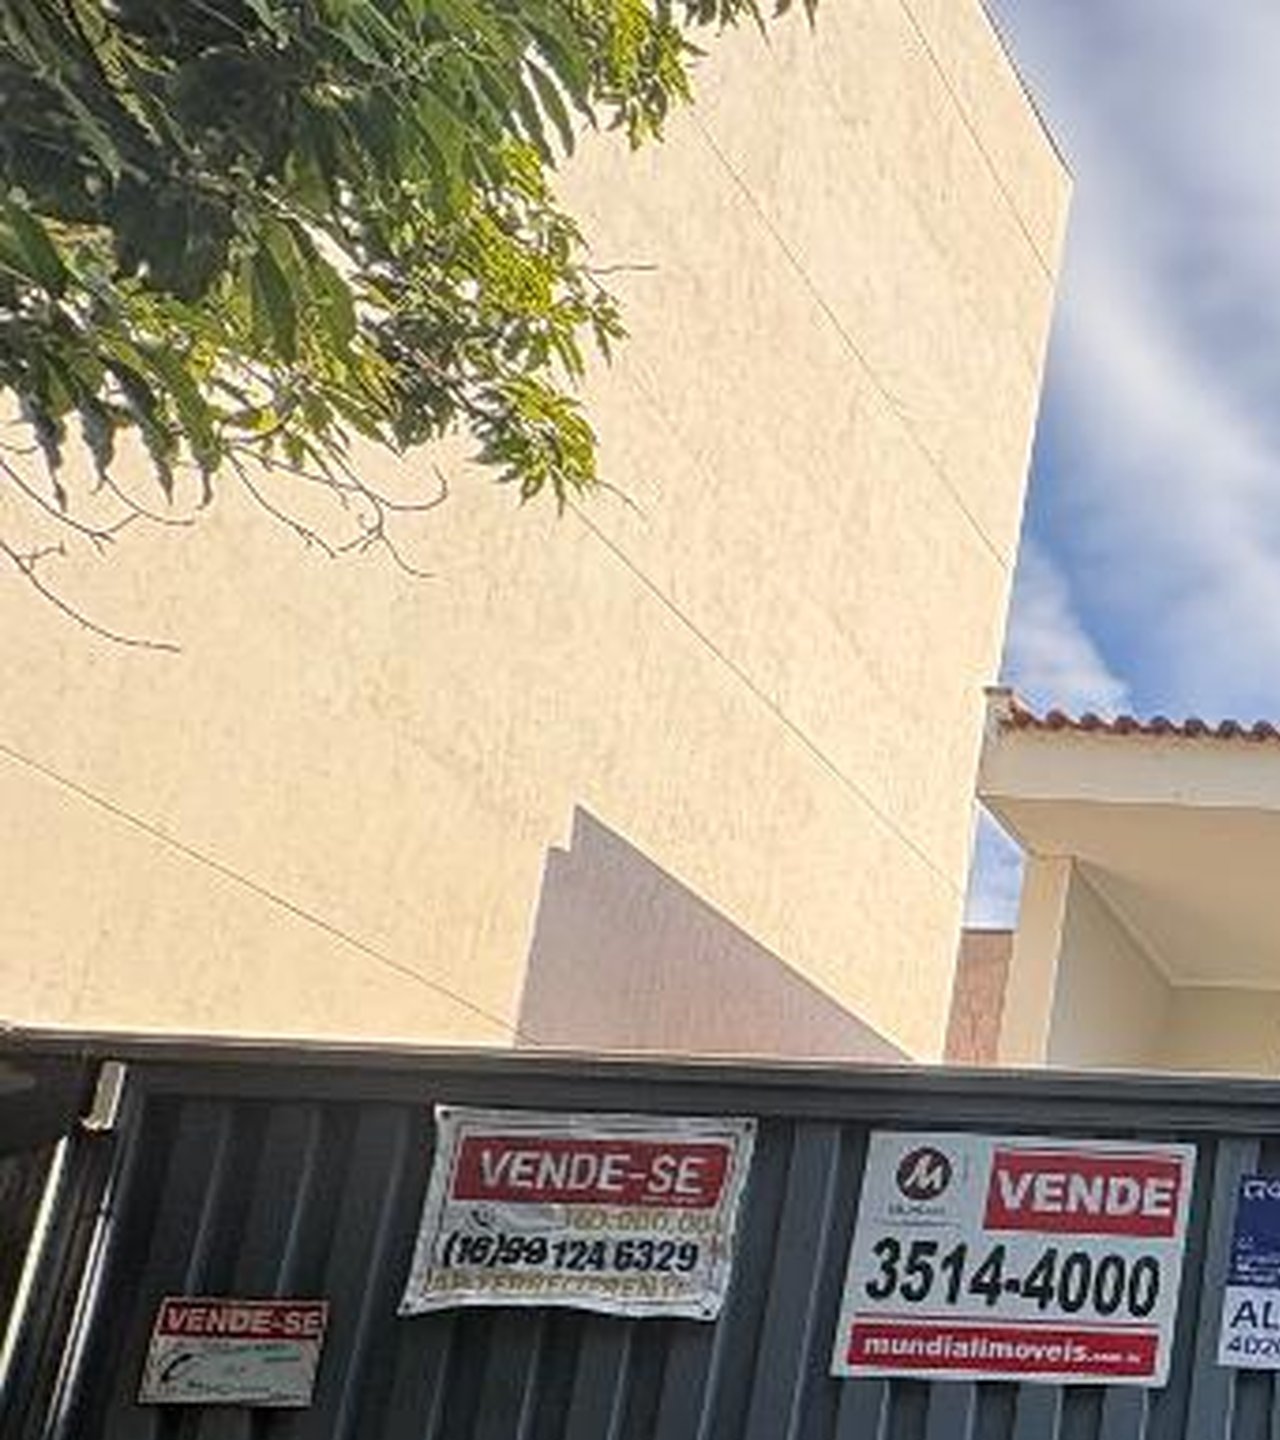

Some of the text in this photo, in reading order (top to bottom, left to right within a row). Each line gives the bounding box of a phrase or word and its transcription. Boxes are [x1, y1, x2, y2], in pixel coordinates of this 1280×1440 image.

[480, 1148, 709, 1195] VENDE-SE
[997, 1169, 1176, 1218] VENDE
[865, 1235, 1161, 1318] 3514-4000
[167, 1305, 320, 1335] VENDE-SE
